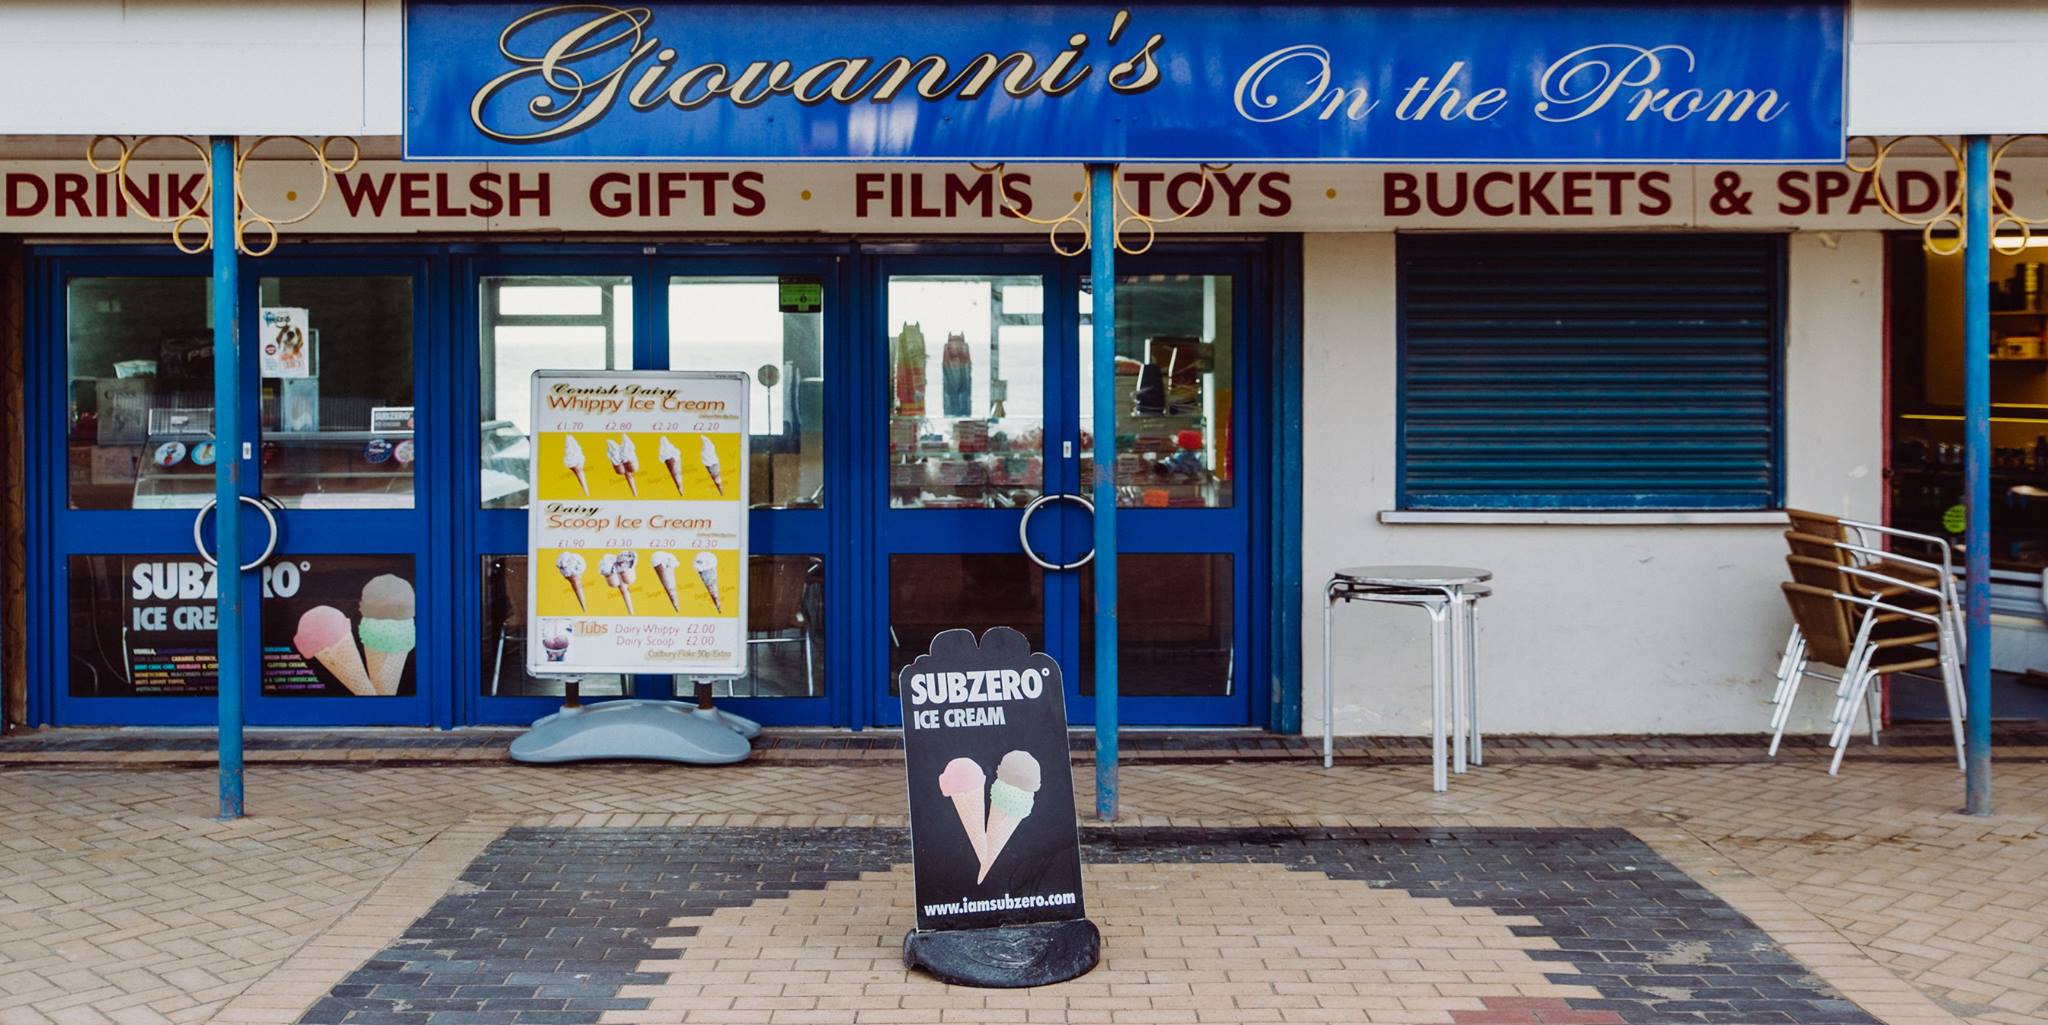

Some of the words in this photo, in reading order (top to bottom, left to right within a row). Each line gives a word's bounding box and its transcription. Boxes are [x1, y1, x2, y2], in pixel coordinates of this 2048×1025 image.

[471, 4, 1163, 143] Giovanni's
[1233, 43, 1380, 123] On
[1395, 60, 1508, 122] the
[1534, 43, 1790, 123] Prom
[5, 173, 243, 218] DRINK
[334, 171, 551, 218] WELSH
[588, 171, 767, 218] GIFTS
[855, 171, 1034, 219] FILMS
[1124, 171, 1293, 218] TOYS
[1383, 170, 1673, 218] BUCKETS
[1708, 170, 1754, 217] &
[551, 383, 620, 396] Cornish
[624, 383, 684, 398] Dairy
[547, 395, 624, 413] Whippy
[629, 396, 656, 411] Ice
[661, 396, 726, 412] Cream
[557, 422, 584, 431] £1.70
[605, 422, 632, 431] £2.80
[652, 422, 679, 431] £2.20
[693, 422, 720, 431] £2.20
[546, 502, 603, 516] Dairy
[548, 514, 611, 532] Scoop
[616, 515, 643, 529] Ice
[649, 514, 713, 529] Cream
[558, 538, 585, 548] £1.90
[133, 606, 167, 632] ICE
[173, 605, 218, 632] CRE
[577, 620, 609, 634] Tubs
[615, 623, 641, 636] Dairy
[643, 623, 680, 636] Whippy
[687, 623, 716, 634] £2.00
[616, 635, 642, 648] Dairy
[646, 635, 676, 647] Scoop
[686, 635, 714, 646] £2.00
[913, 709, 941, 730] ICE
[943, 706, 1006, 728] CREAM
[924, 893, 1076, 917] www.iamsubzero.com
